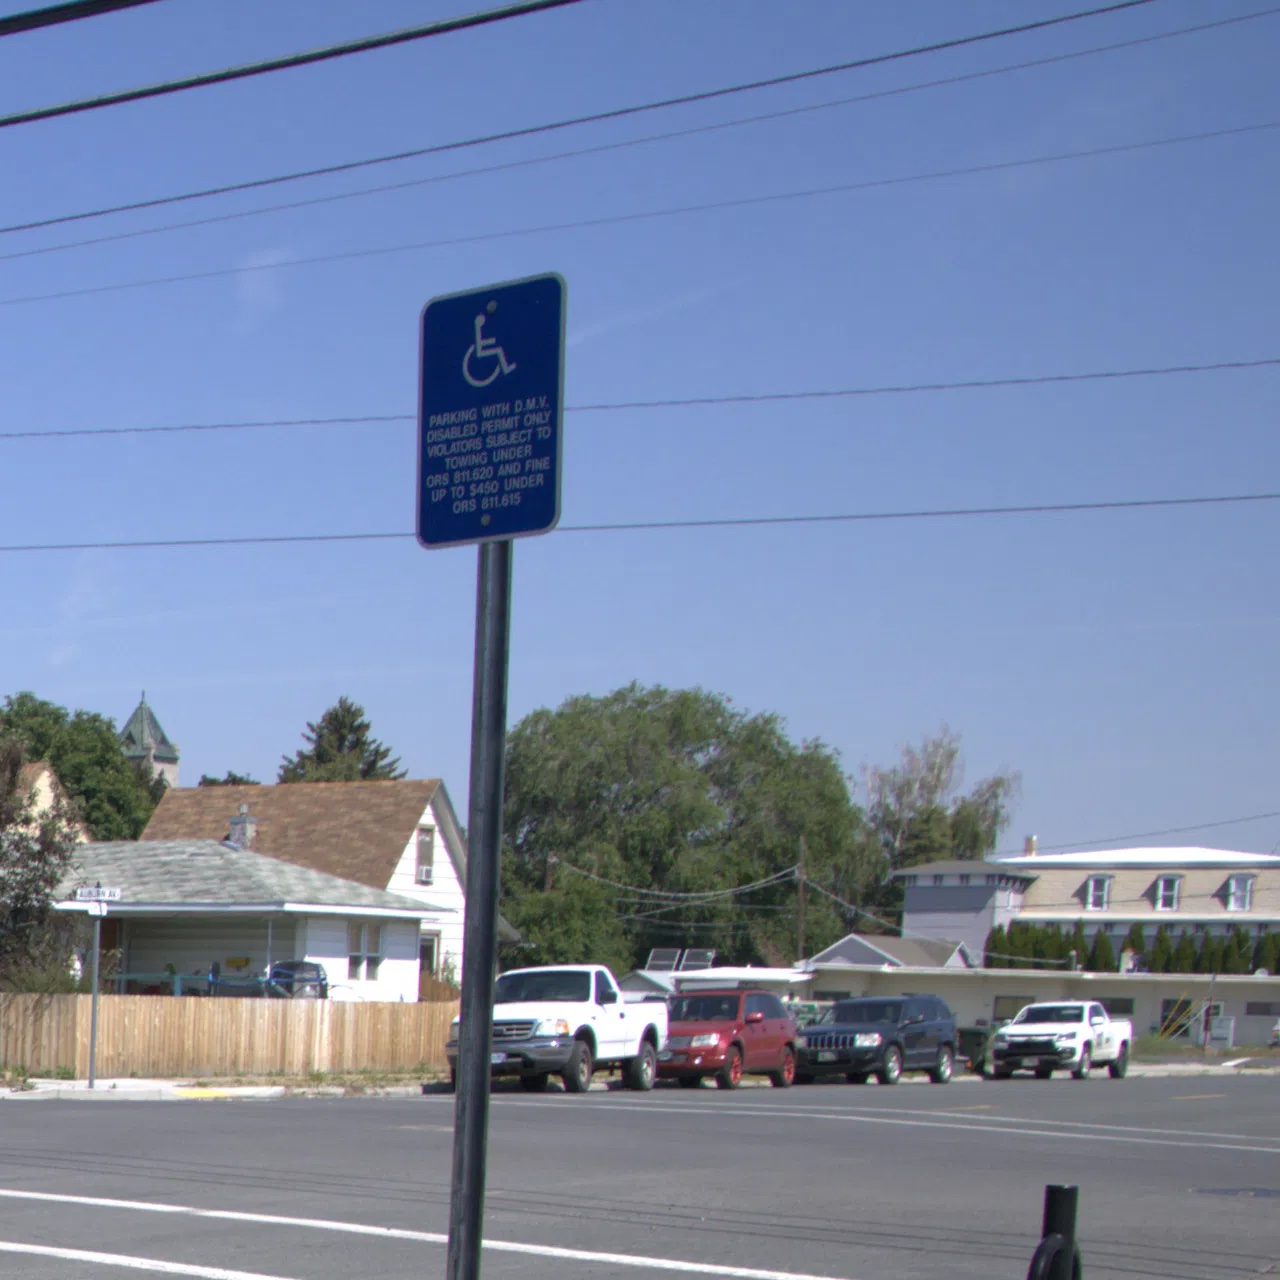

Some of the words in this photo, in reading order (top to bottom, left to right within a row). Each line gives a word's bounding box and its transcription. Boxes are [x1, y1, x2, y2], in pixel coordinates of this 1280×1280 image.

[426, 424, 478, 443] DISABLED
[481, 415, 520, 434] PERMIT
[523, 410, 552, 426] ONLY
[429, 408, 478, 427] PARKING
[482, 402, 510, 418] WITH
[514, 396, 550, 412] D.M.V.
[427, 437, 482, 458] VIOLATORS
[486, 429, 532, 448] SUBJECT
[536, 426, 552, 440] TO
[444, 452, 488, 470] TOWING
[493, 444, 532, 462] UNDER
[426, 472, 450, 488] ORS
[454, 466, 494, 484] 811.620
[497, 462, 521, 477] AND
[524, 456, 550, 472] FINE
[431, 488, 447, 502] UP
[450, 485, 464, 499] TO
[469, 480, 499, 496] $450
[504, 474, 544, 490] UNDER
[452, 498, 476, 514] ORS
[482, 492, 521, 510] 811.615
